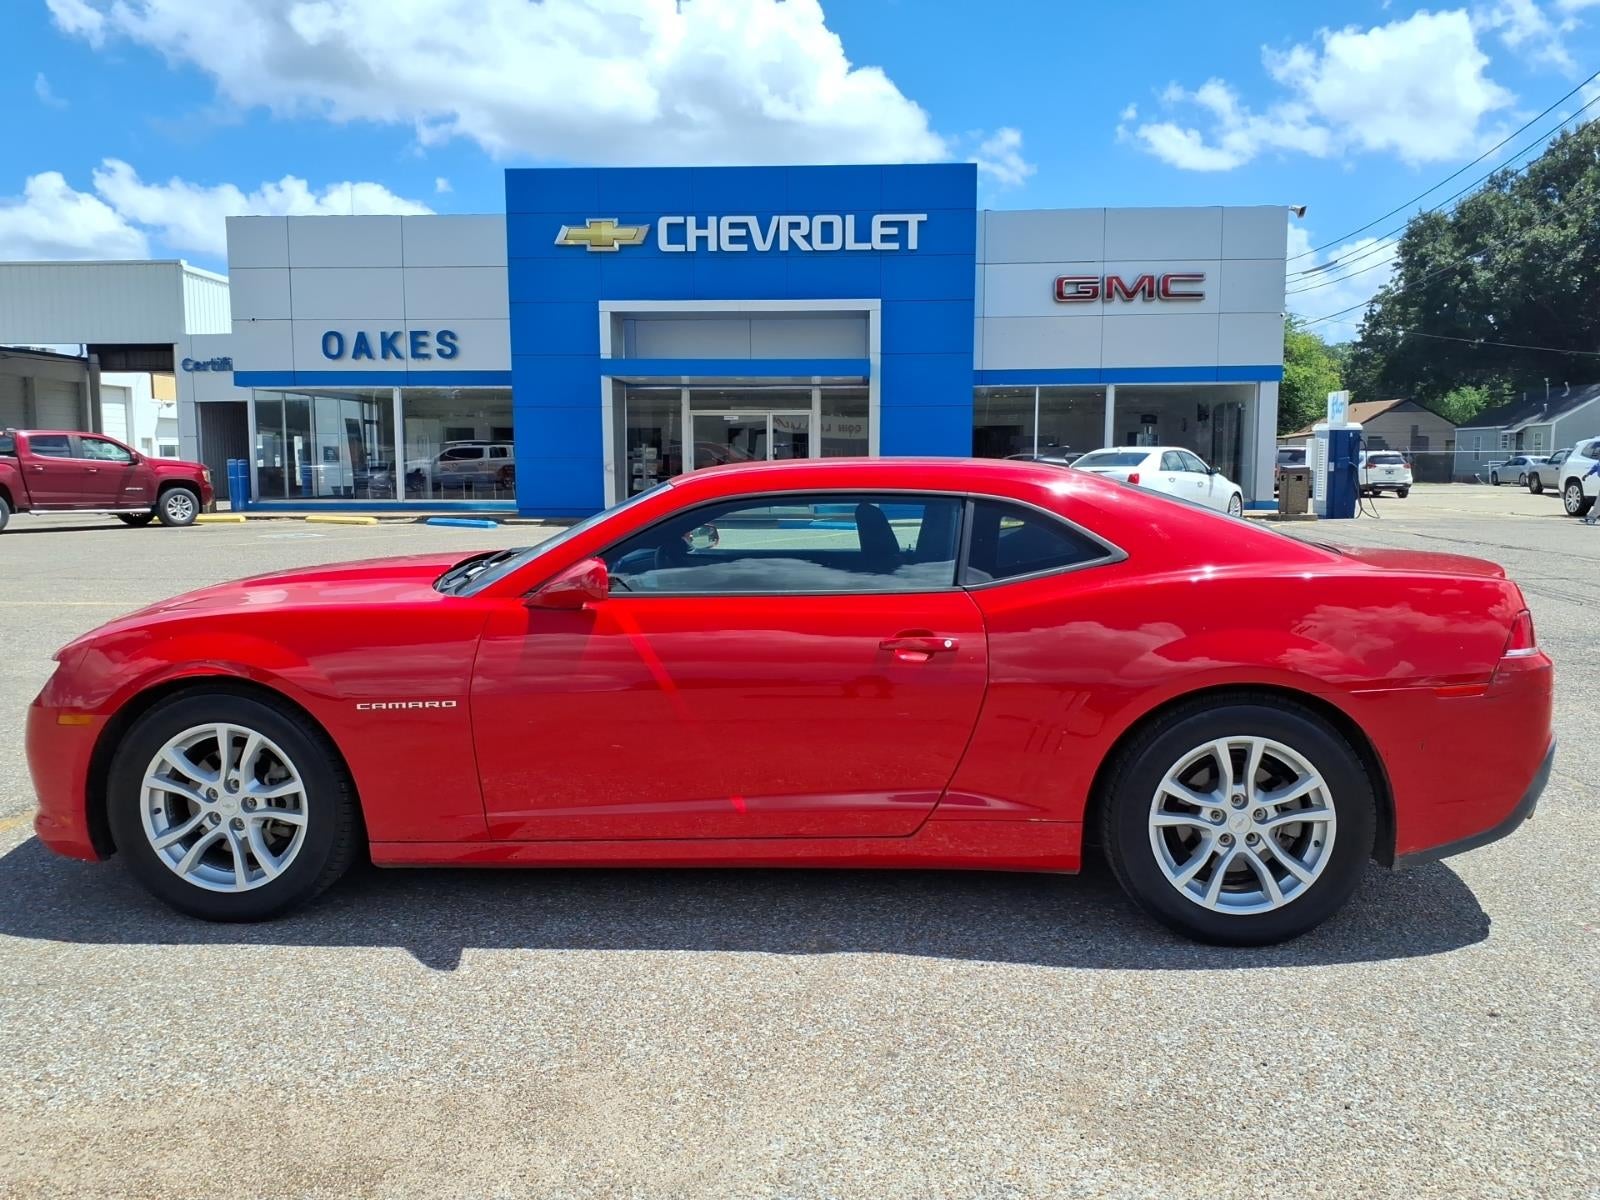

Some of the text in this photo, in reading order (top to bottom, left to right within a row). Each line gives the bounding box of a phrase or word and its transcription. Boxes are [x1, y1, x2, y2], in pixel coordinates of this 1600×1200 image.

[657, 213, 928, 252] CHEVROLET
[1054, 272, 1206, 302] GMC
[321, 330, 459, 360] OAKES
[356, 700, 457, 710] CAMARO
